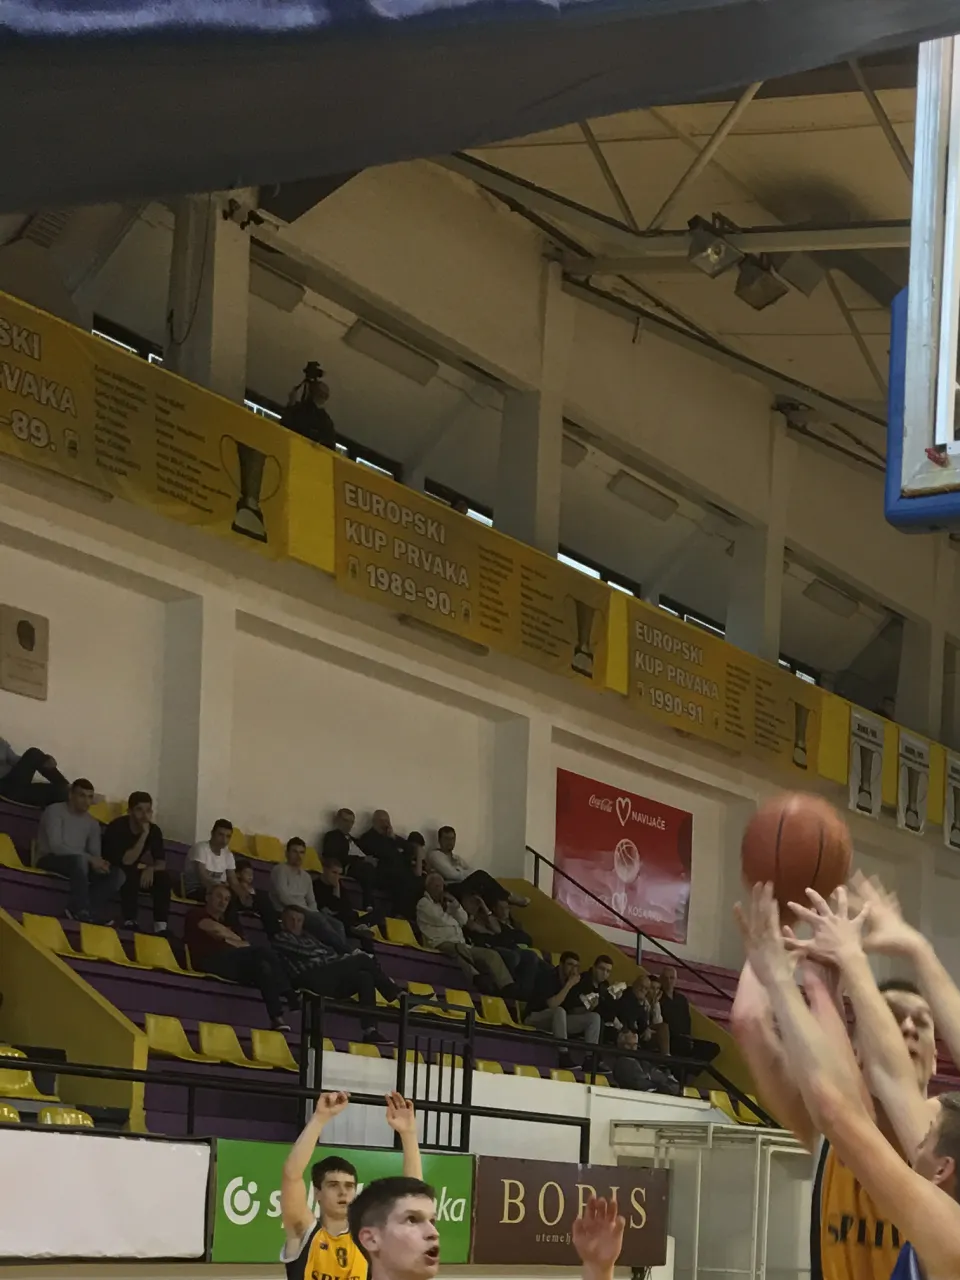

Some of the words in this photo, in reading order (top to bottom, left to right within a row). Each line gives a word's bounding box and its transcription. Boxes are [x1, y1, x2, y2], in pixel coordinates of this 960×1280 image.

[343, 482, 446, 544] EUROPSKI
[344, 518, 388, 552] KUP
[393, 539, 470, 588] PRVAKA
[635, 620, 703, 667] EUROPSKI
[634, 649, 664, 677] KUP
[667, 665, 720, 701] PRVAKA
